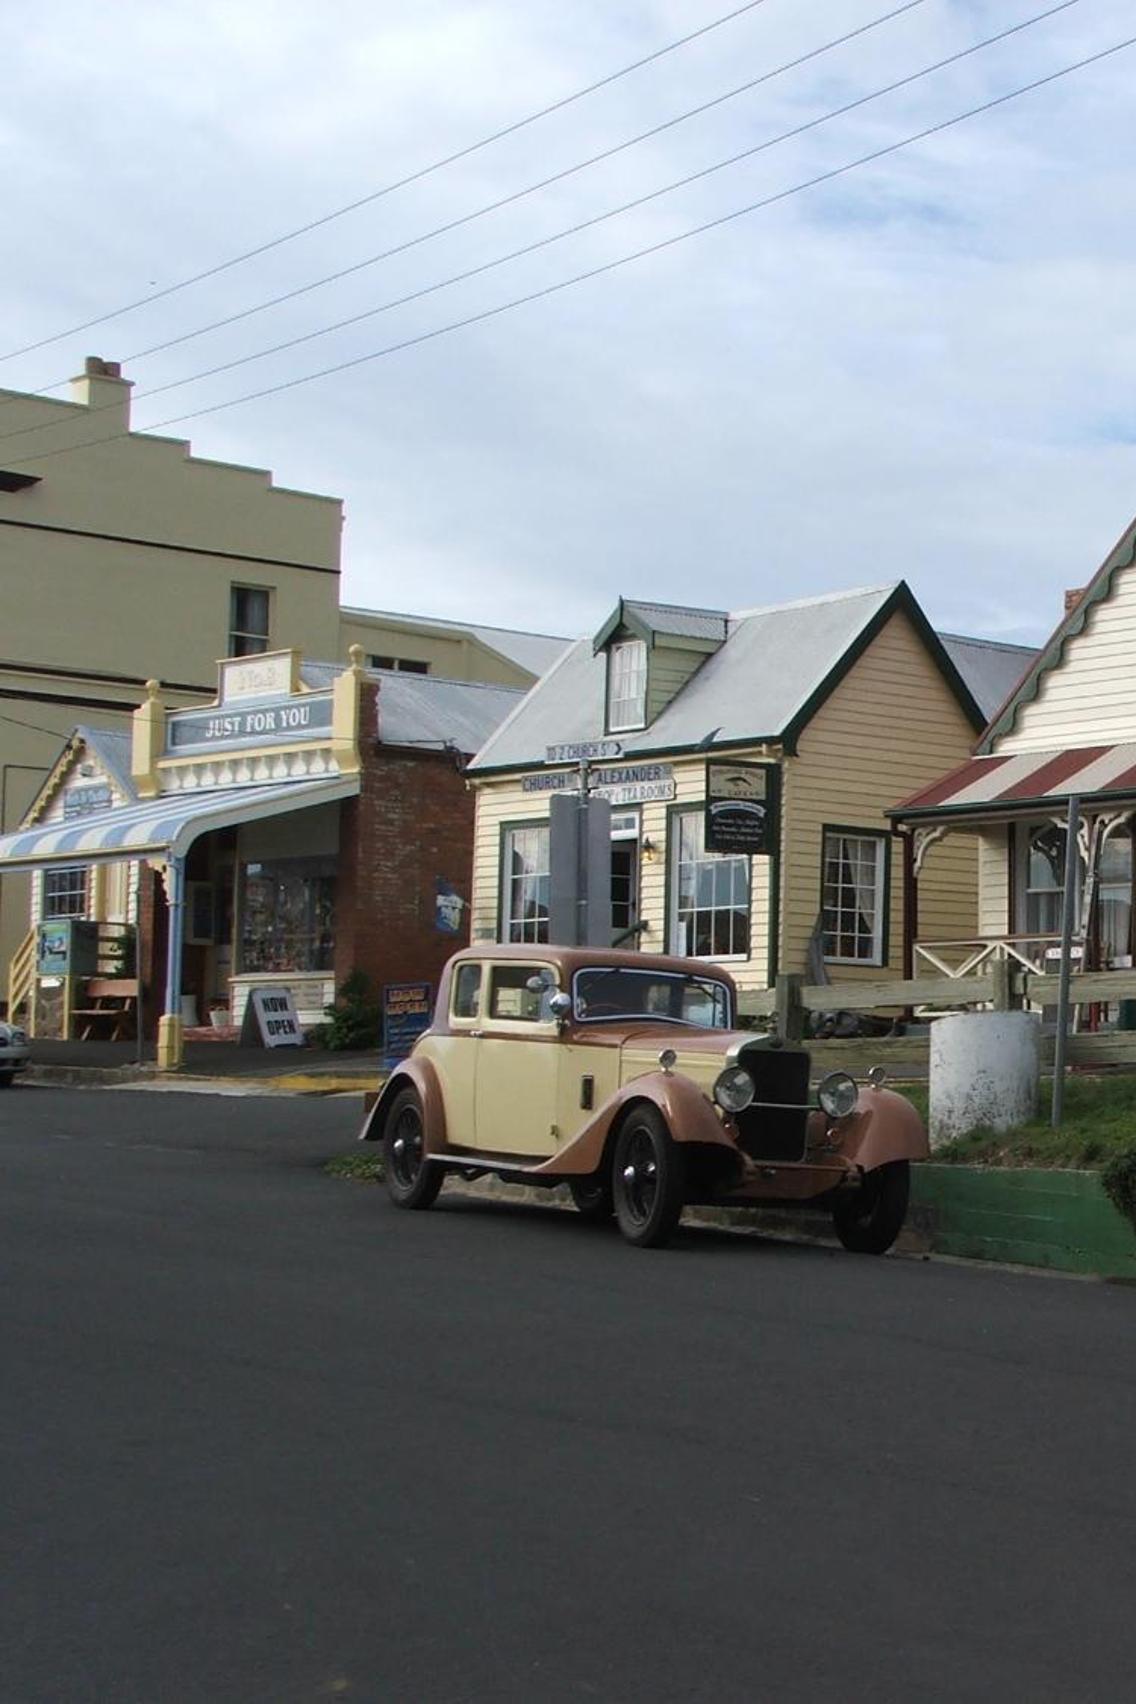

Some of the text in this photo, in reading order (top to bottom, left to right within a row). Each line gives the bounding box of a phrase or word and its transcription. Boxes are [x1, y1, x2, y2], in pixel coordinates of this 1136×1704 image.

[206, 706, 310, 737] JUST FOR YOU
[522, 775, 566, 793] CHURCH
[597, 766, 662, 784] ALEXANDER
[261, 997, 289, 1013] NOW
[267, 1018, 297, 1036] OPEN
